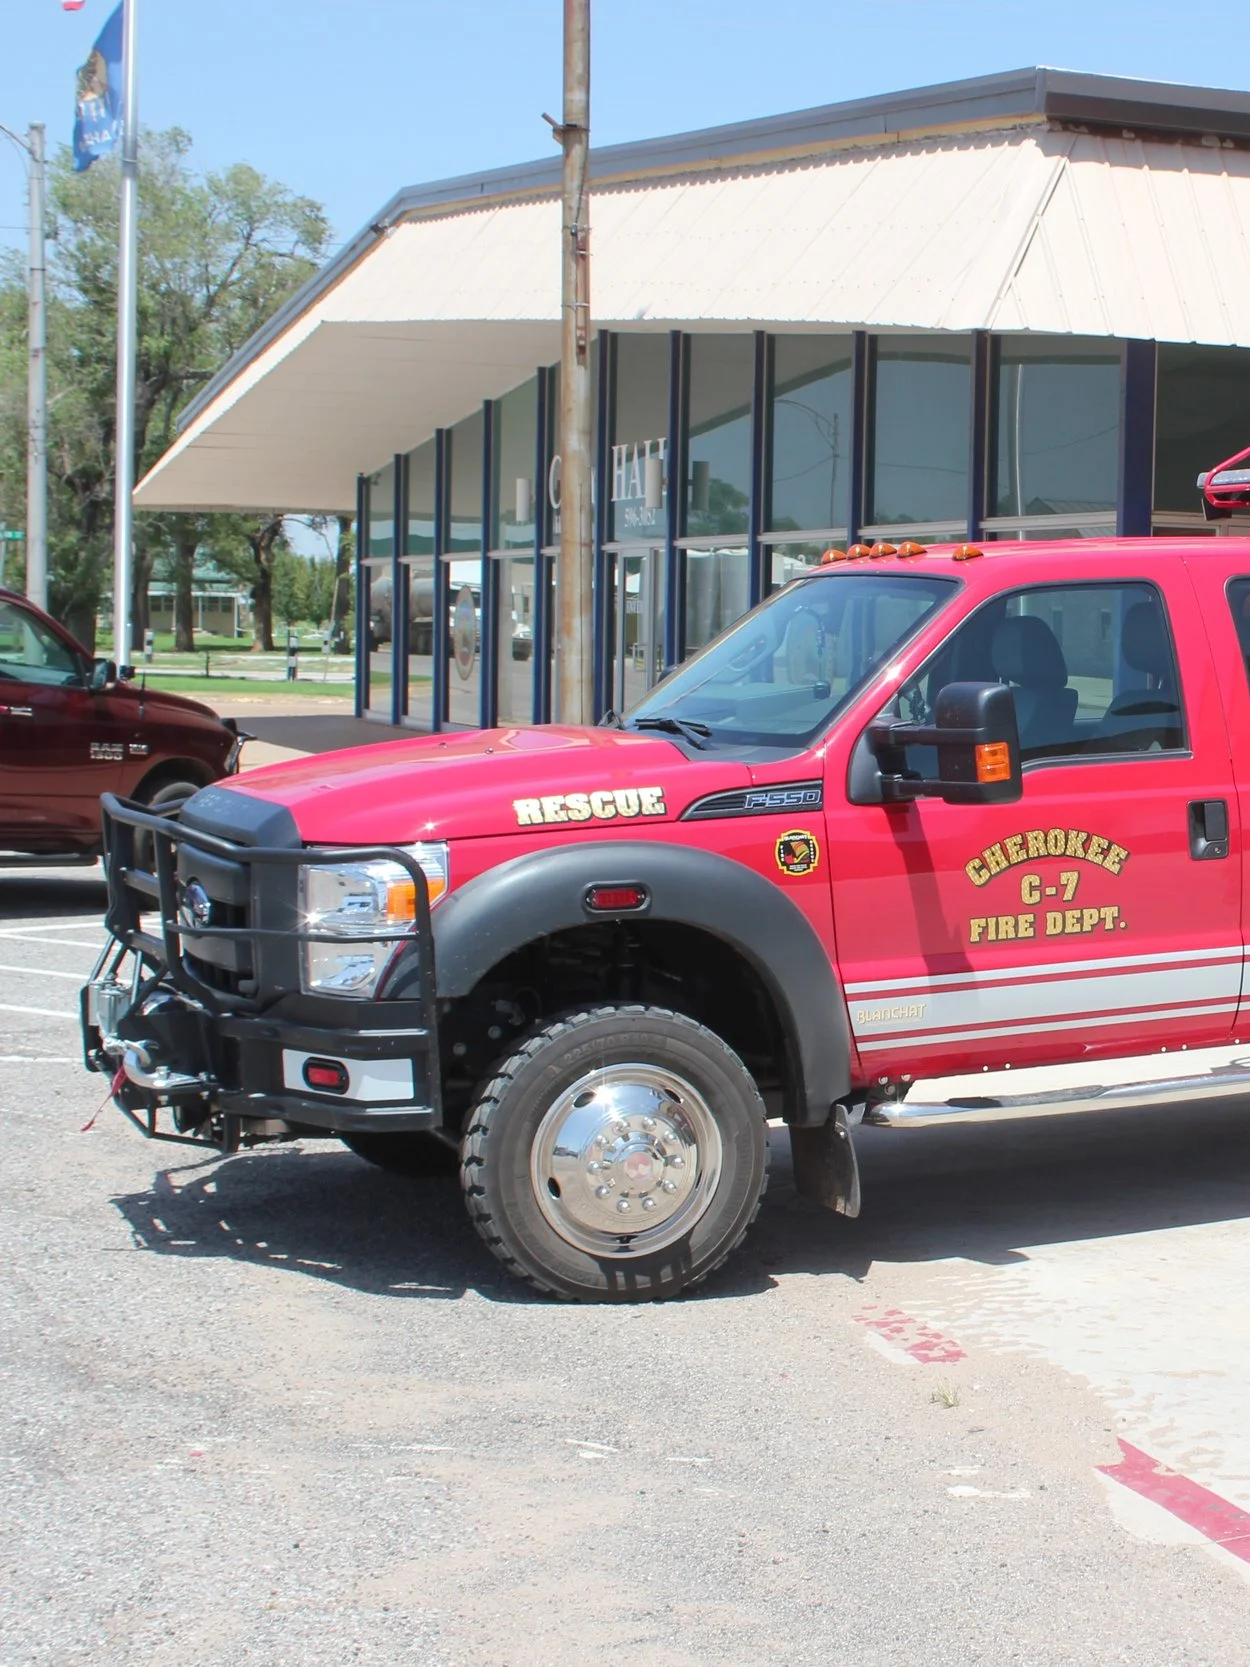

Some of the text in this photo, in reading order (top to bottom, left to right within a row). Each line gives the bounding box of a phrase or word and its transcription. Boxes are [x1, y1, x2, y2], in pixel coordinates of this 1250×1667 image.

[513, 787, 667, 827] RESCUE
[744, 790, 822, 810] F-550
[965, 827, 1129, 887] CHEROKEE
[1020, 870, 1080, 905] C-7
[970, 906, 1128, 943] FIRE DEPT.
